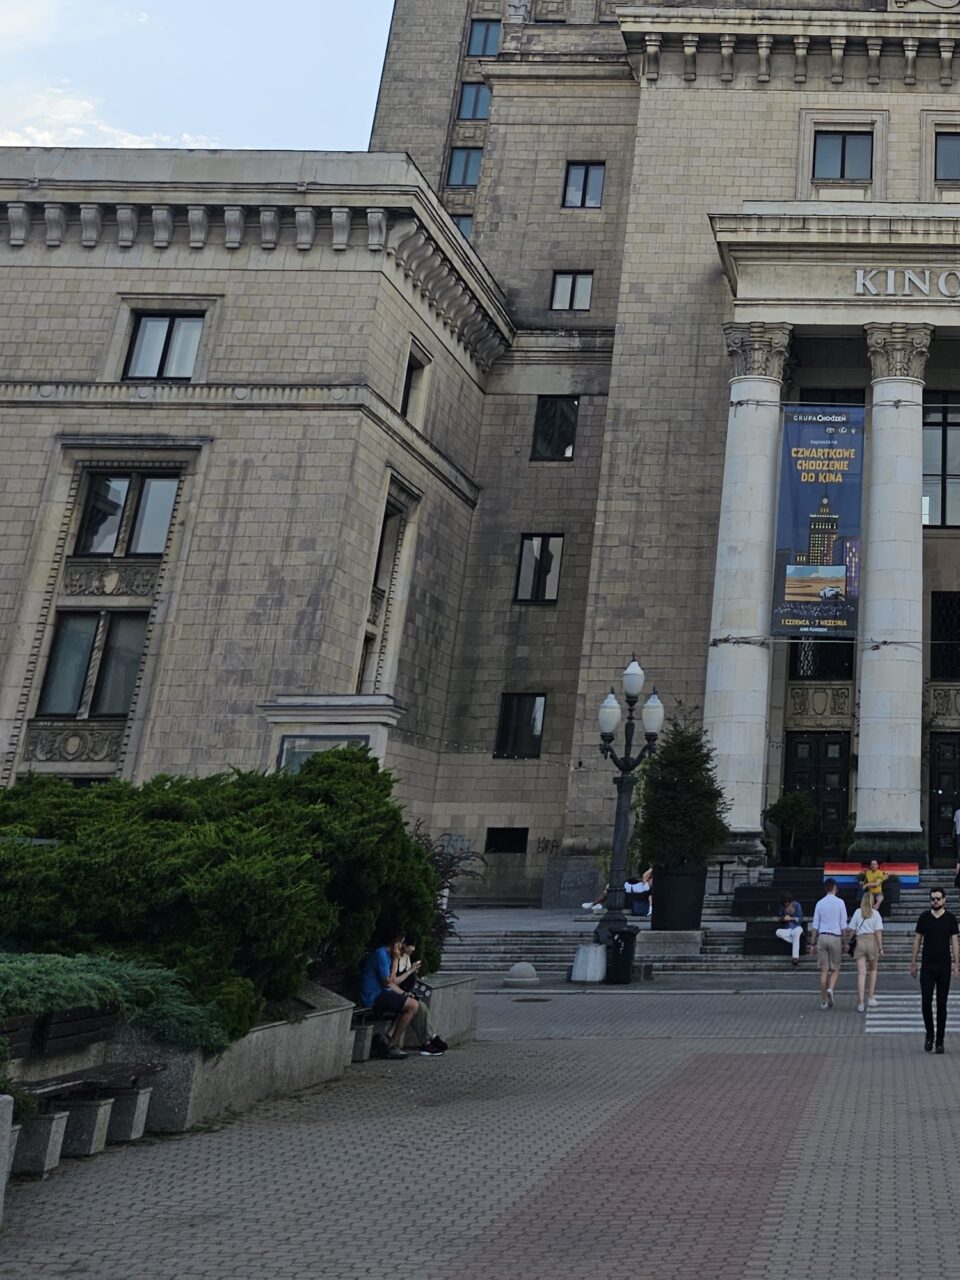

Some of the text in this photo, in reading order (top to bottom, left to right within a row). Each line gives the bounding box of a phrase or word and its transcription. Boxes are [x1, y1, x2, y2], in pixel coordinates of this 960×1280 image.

[791, 448, 856, 459] CZWARTKOWE
[796, 460, 849, 471] CHODZENIE
[801, 472, 843, 483] DO KINA
